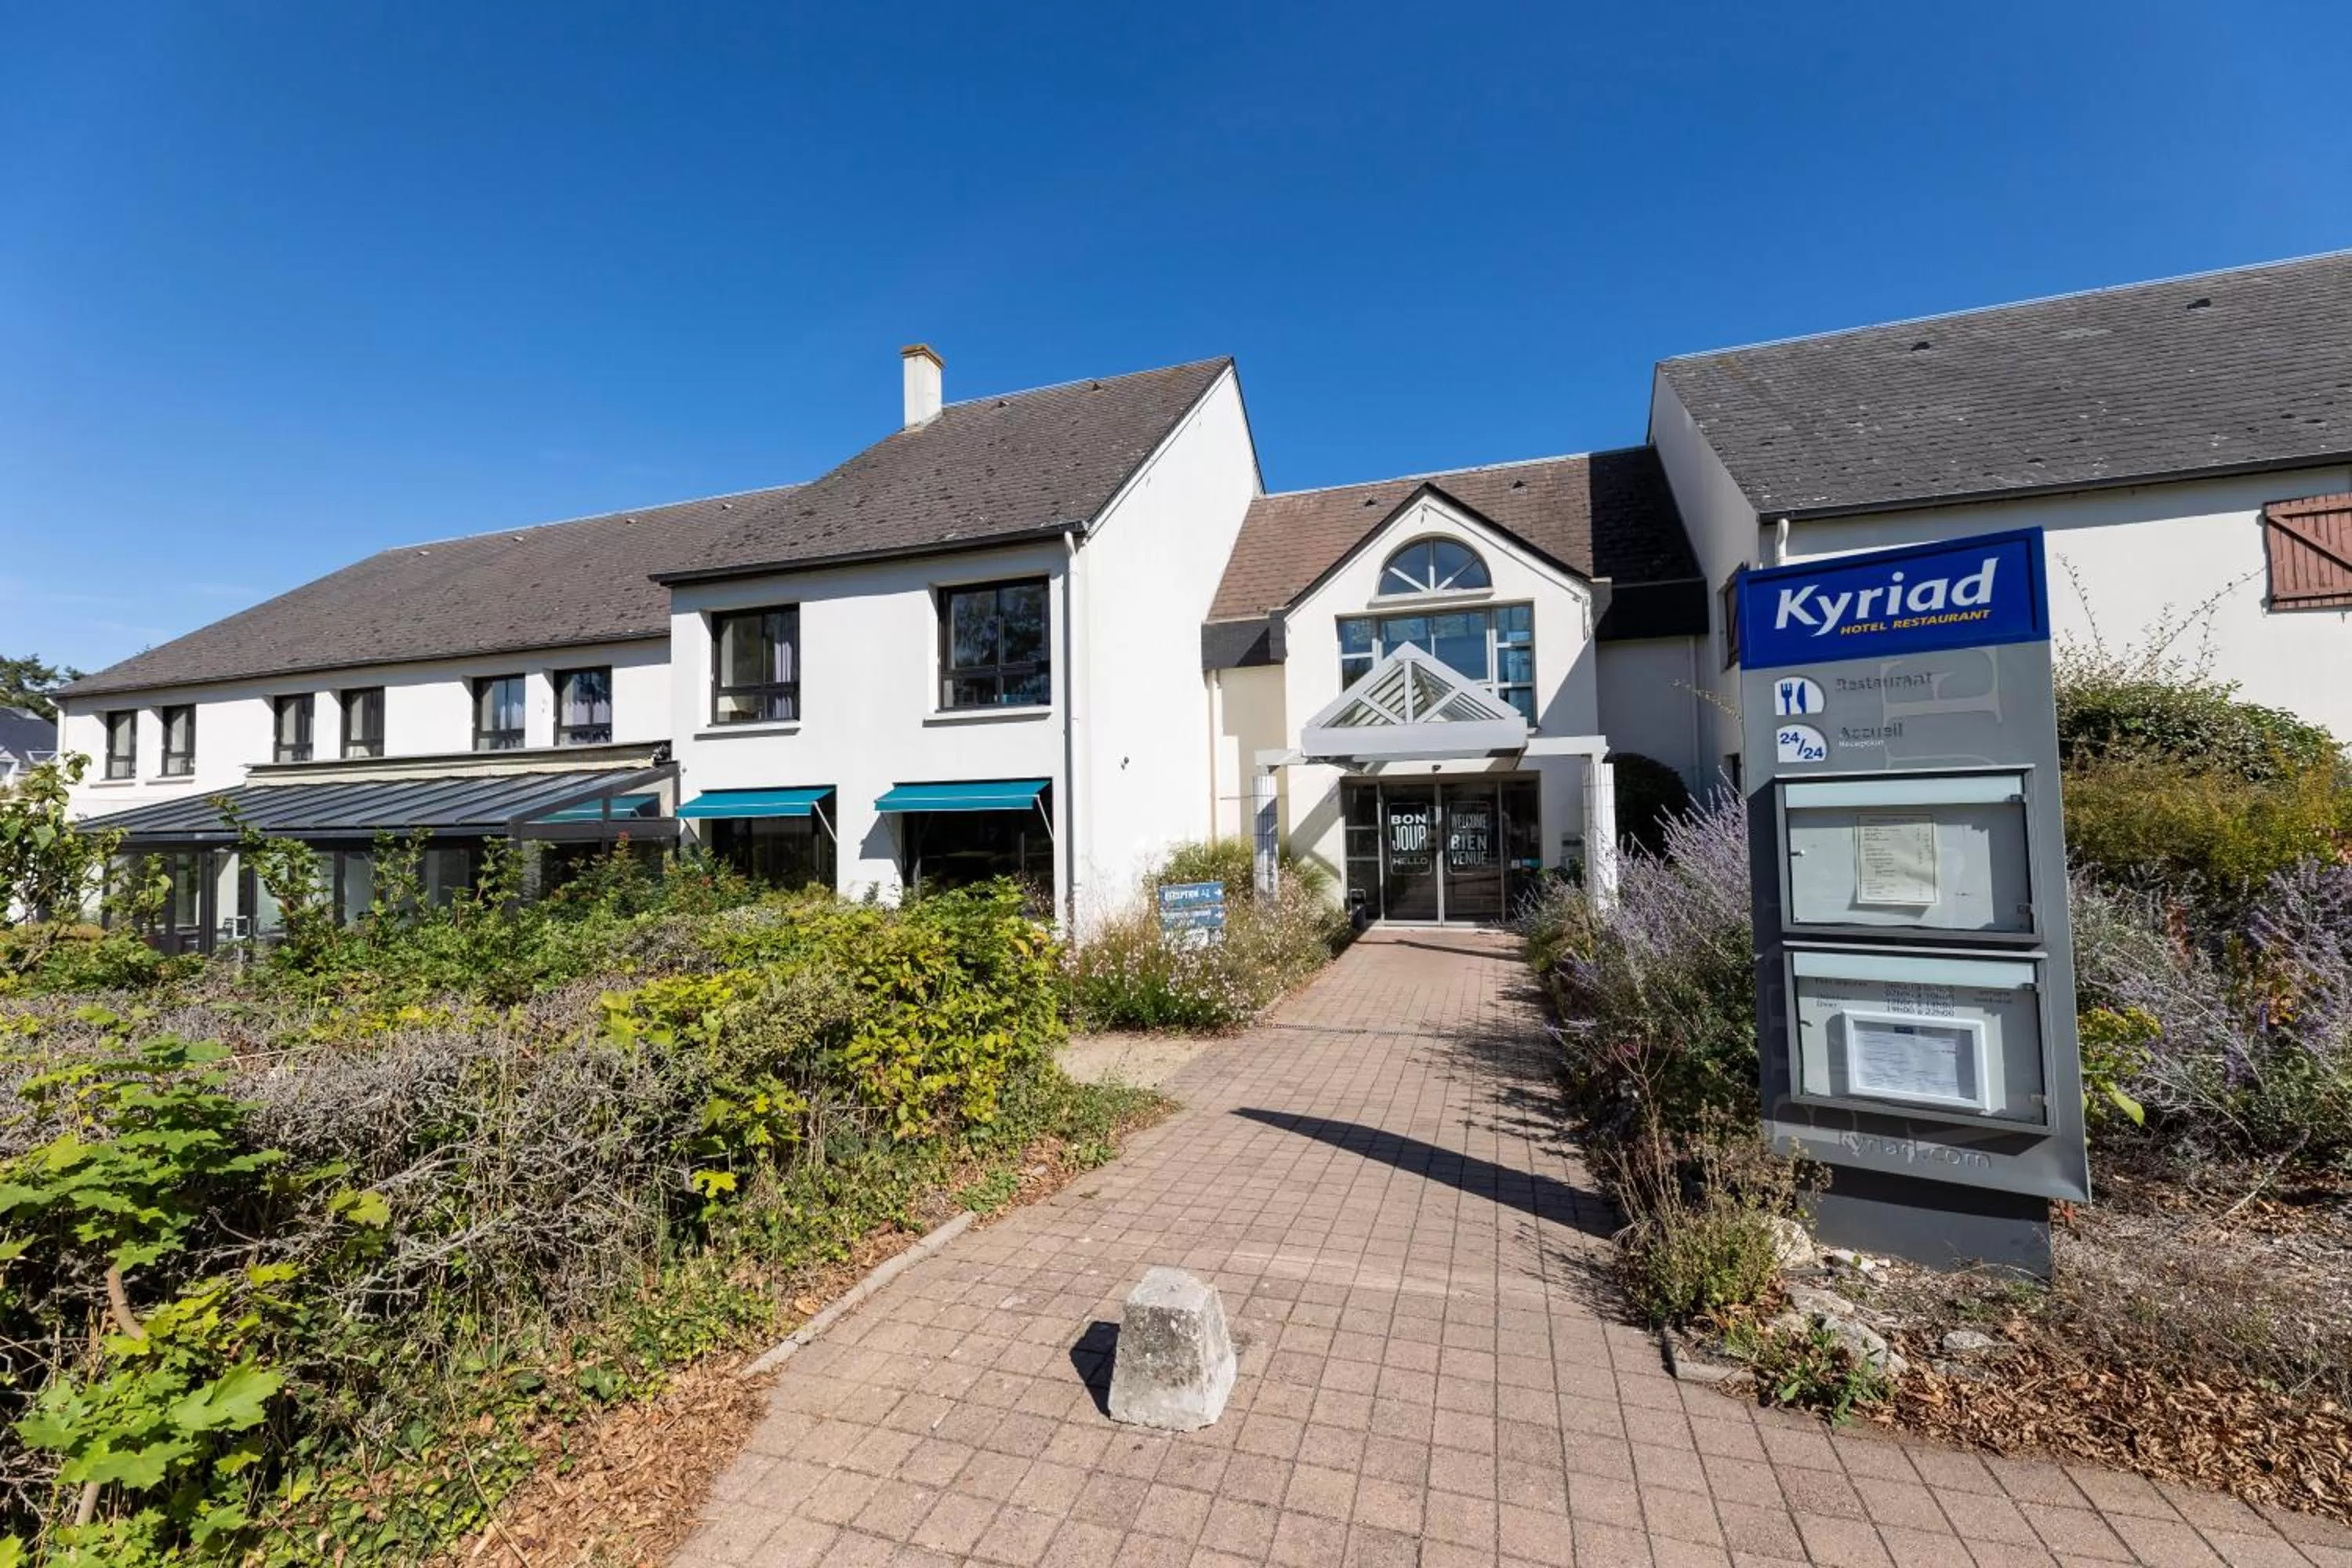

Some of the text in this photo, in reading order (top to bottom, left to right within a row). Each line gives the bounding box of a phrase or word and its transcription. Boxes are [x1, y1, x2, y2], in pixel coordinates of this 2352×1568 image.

[1774, 557, 1999, 637] Kyriad
[1840, 608, 1992, 636] HOTEL RESTAURANT
[1836, 671, 1933, 691] Restaurant
[1839, 721, 1904, 739] Accueil
[1391, 814, 1427, 824] BON
[1392, 825, 1427, 851] JOUR
[1450, 834, 1487, 850] BIEN
[1392, 857, 1428, 866] HELLO
[1450, 851, 1487, 866] VENUE
[1839, 1128, 1991, 1167] kyriad.com
